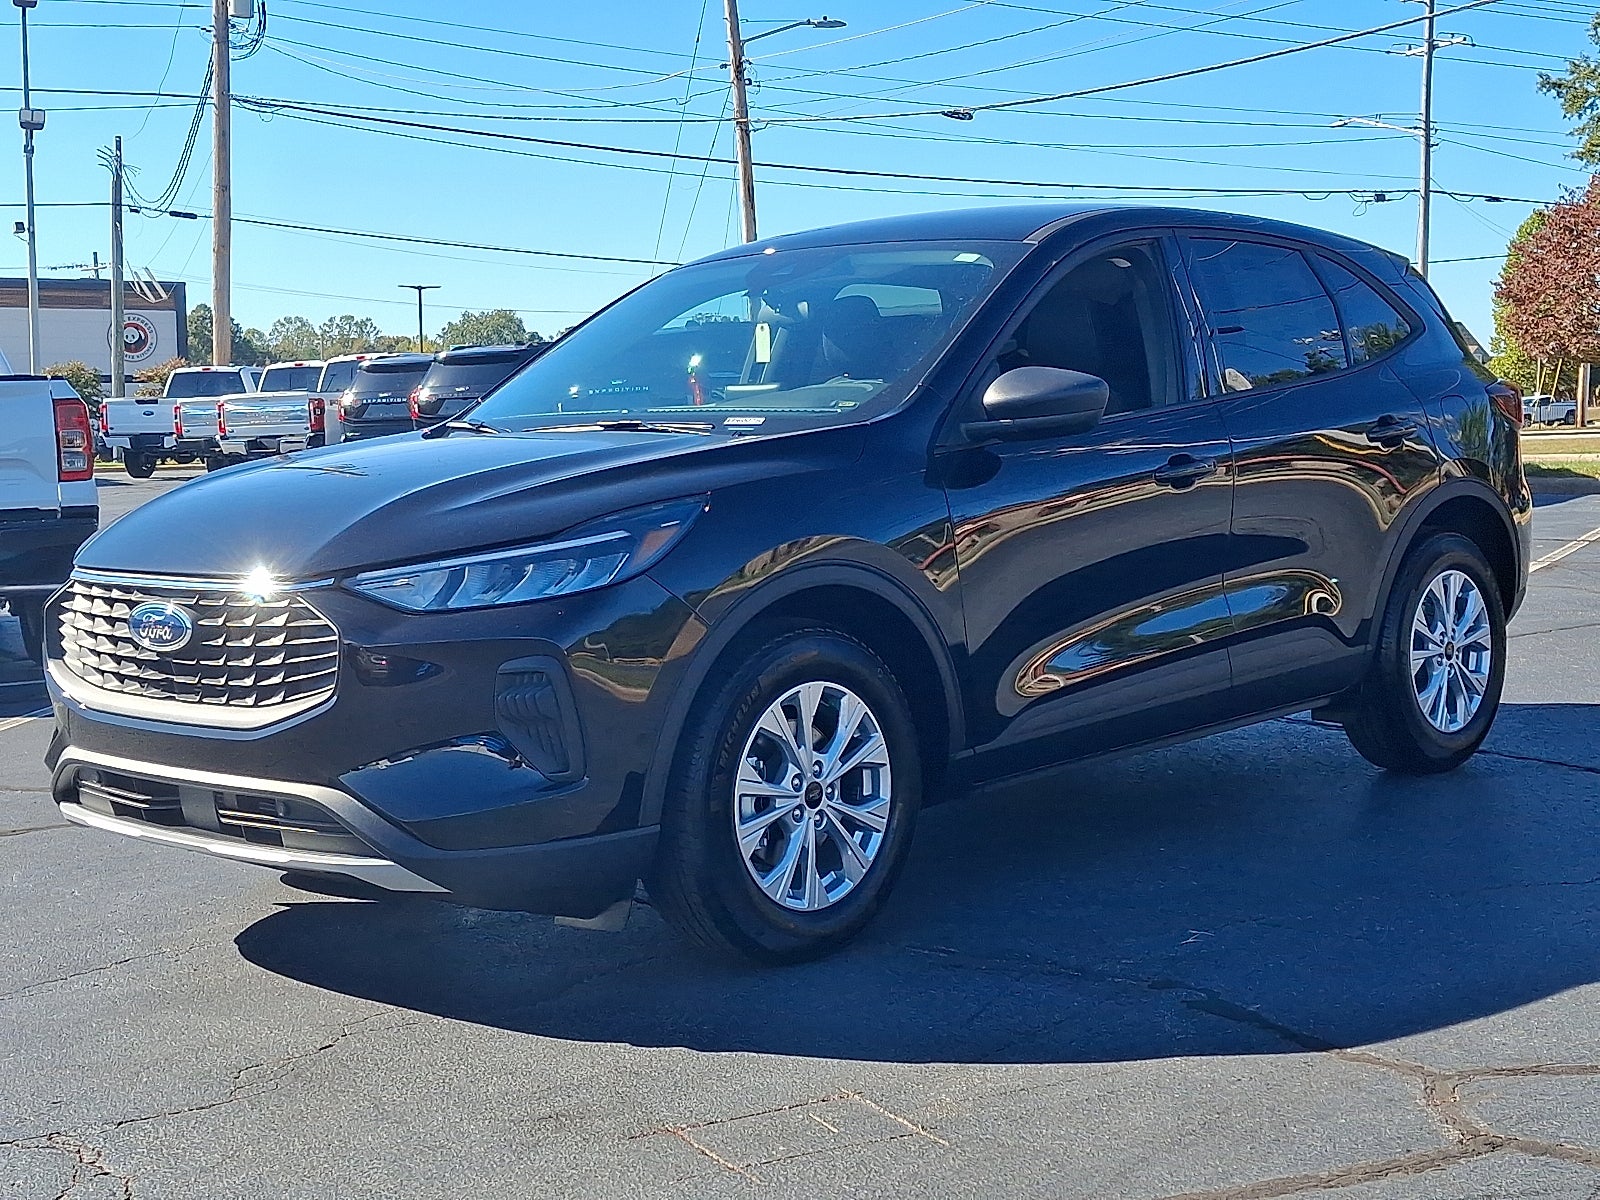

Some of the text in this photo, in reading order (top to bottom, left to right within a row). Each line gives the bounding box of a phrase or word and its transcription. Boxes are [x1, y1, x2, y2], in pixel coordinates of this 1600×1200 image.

[127, 316, 154, 334] EXPRESS
[139, 613, 175, 640] Ford
[719, 685, 760, 769] MICHELIN
